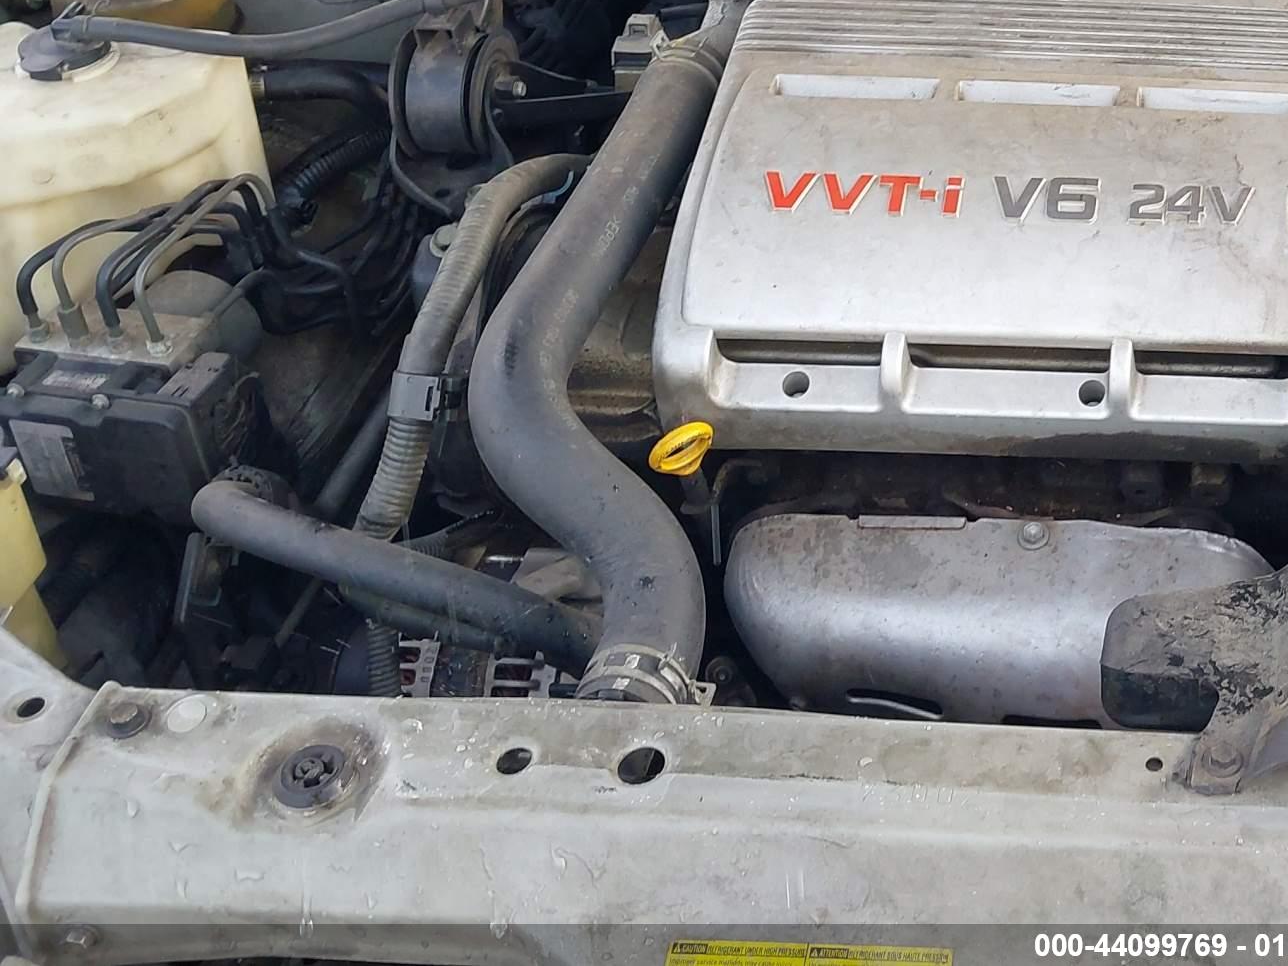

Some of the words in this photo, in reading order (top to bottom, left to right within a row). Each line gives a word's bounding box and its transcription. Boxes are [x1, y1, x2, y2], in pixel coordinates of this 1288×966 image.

[765, 170, 965, 218] VVT-i
[993, 176, 1102, 225] V6
[1127, 184, 1256, 227] 24V
